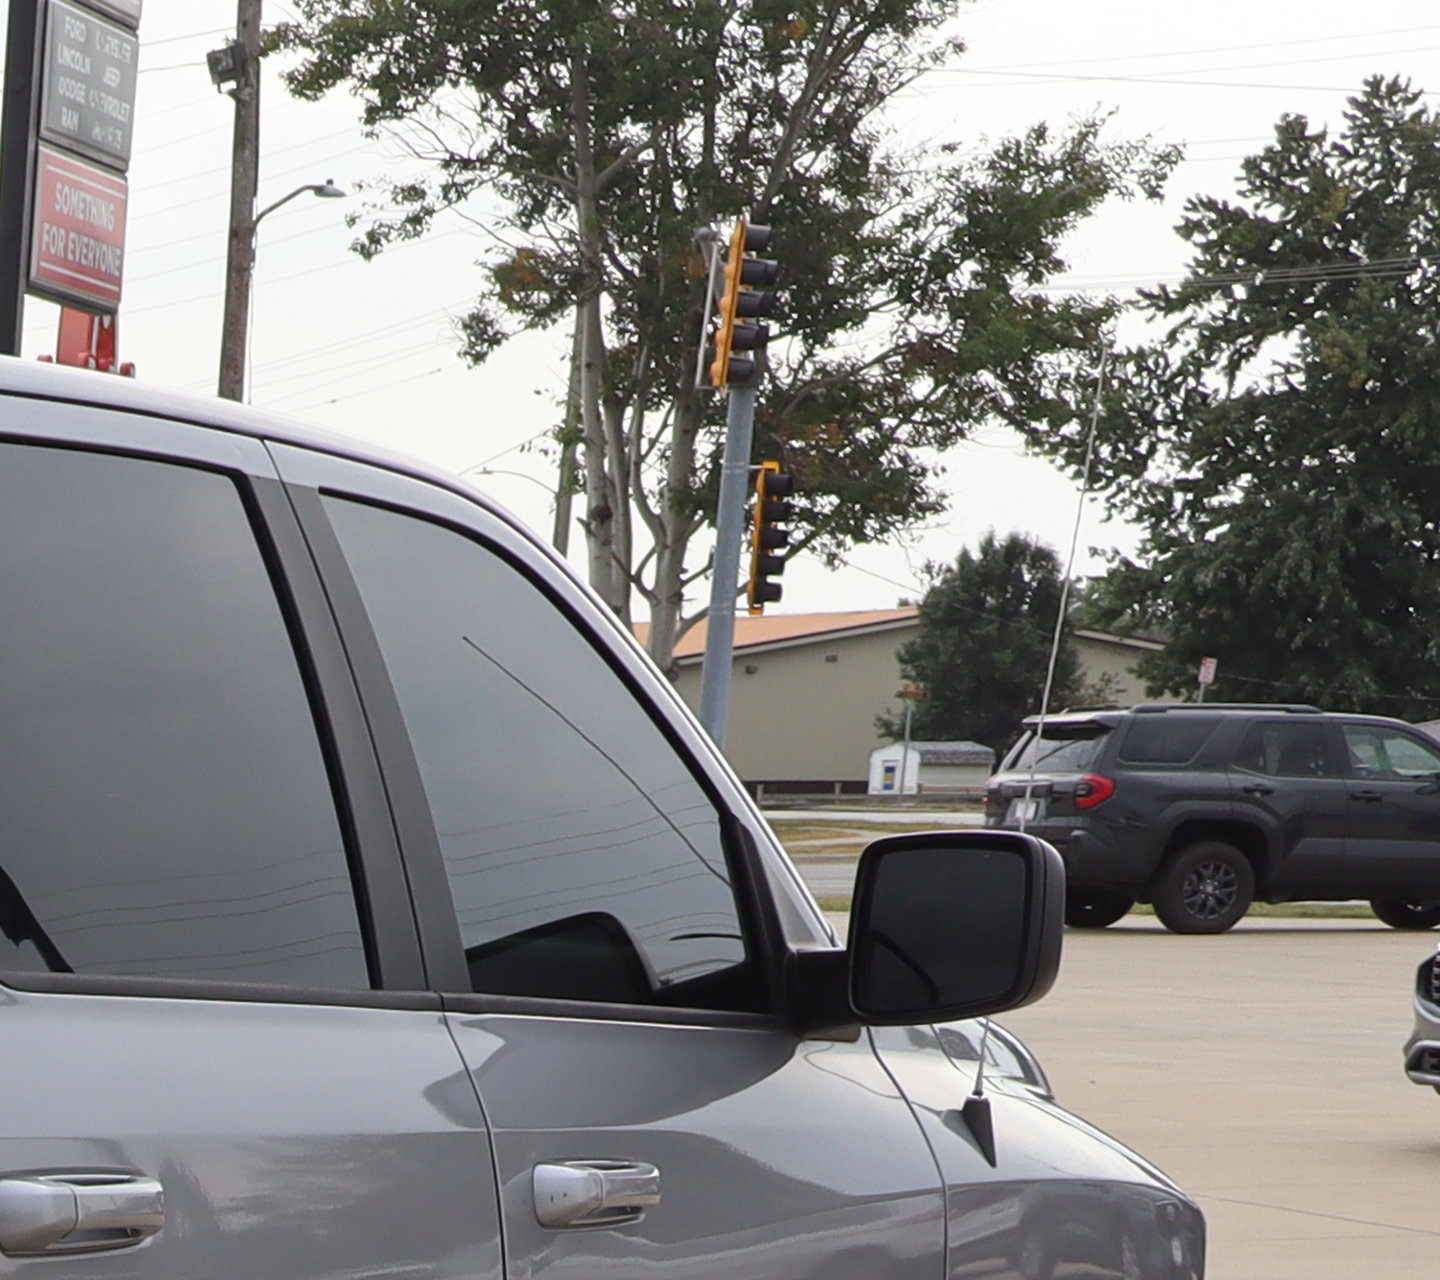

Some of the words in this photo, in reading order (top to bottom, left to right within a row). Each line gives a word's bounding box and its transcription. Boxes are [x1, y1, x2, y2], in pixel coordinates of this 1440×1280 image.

[64, 16, 87, 43] FORD
[58, 43, 91, 74] LINCOLN
[59, 77, 86, 105] DODGE
[61, 106, 80, 132] RAM
[55, 182, 115, 231] SOMETHING
[43, 223, 65, 258] FOR
[68, 232, 121, 276] EVERYONE
